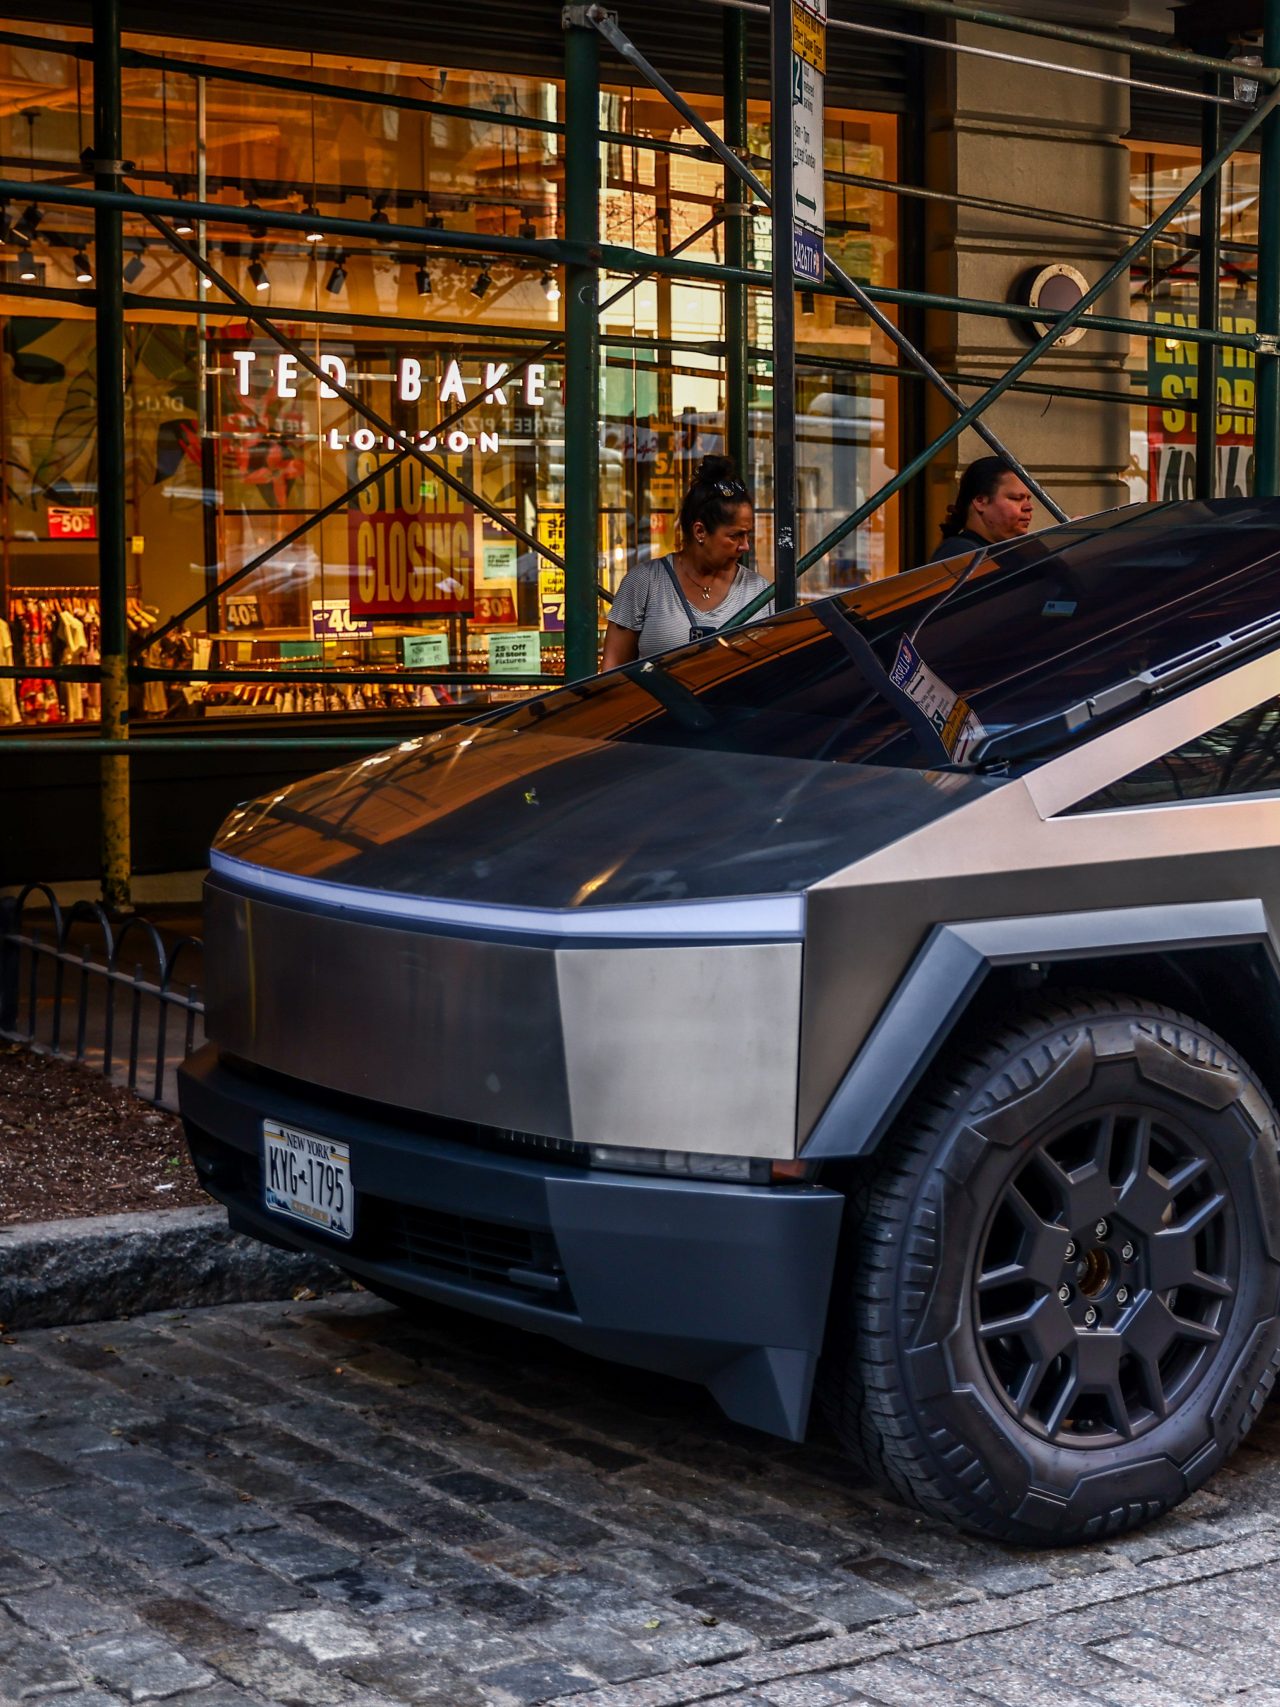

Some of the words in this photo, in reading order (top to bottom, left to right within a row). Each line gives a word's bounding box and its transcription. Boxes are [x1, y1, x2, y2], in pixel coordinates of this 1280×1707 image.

[795, 55, 801, 98] 2
[1155, 311, 1256, 369] ENIR
[233, 351, 347, 398] TED
[402, 358, 566, 405] BAKE
[1161, 374, 1256, 435] STOR
[357, 452, 464, 515] STORE
[357, 521, 470, 604] CLOSING
[286, 1132, 305, 1152] NEW
[307, 1139, 330, 1161] YORK
